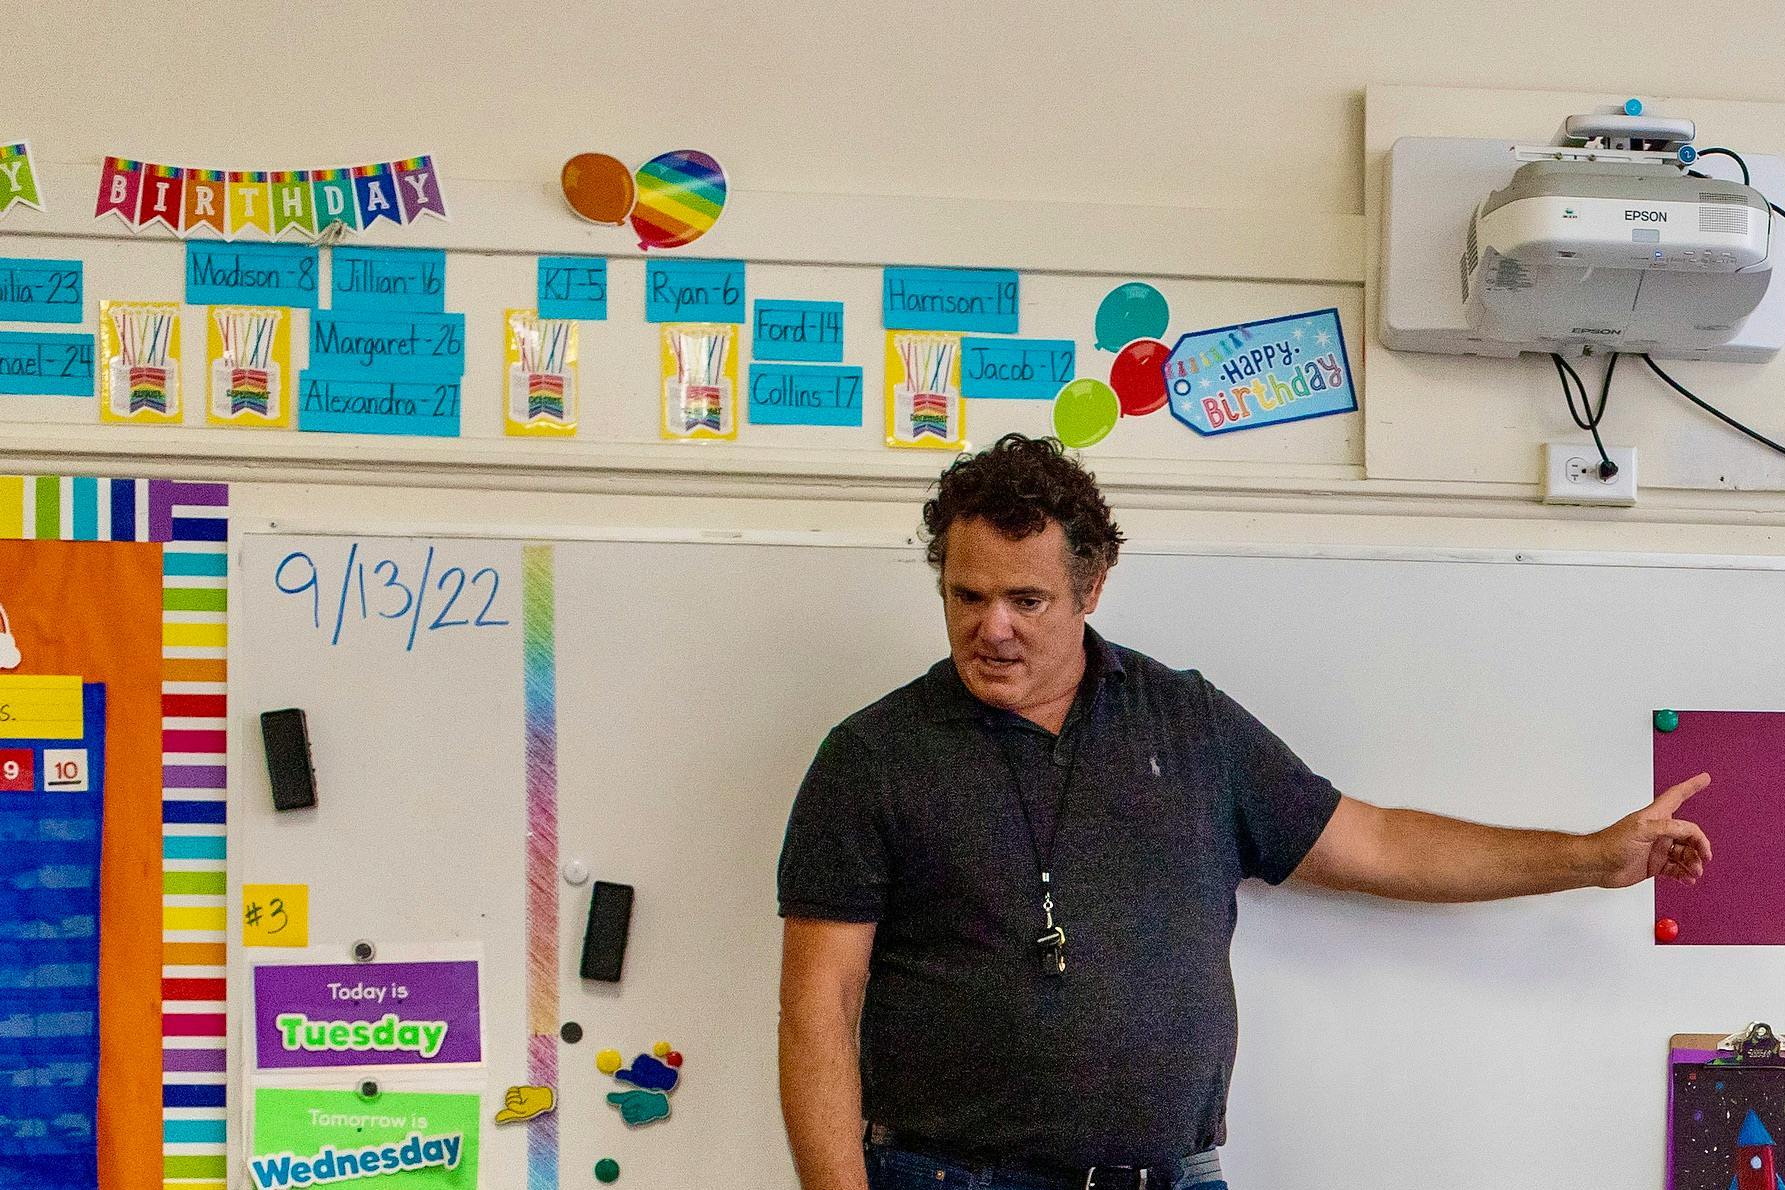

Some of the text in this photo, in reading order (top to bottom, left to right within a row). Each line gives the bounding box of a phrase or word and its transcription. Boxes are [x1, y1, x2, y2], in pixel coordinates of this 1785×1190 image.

[109, 173, 430, 218] BIRTHDAY
[1624, 210, 1668, 223] EPSON
[652, 270, 740, 313] Ryan-6
[1571, 327, 1622, 336] EPSON
[1202, 353, 1343, 429] Birthday
[275, 542, 509, 651] 9/13/22
[2, 760, 19, 780] 9
[54, 760, 78, 780] 10
[245, 897, 288, 935] #3
[327, 983, 408, 1003] Today is
[279, 1016, 446, 1056] Tuesday
[309, 1110, 428, 1129] Tomorrow is
[252, 1134, 461, 1190] Wednesday
